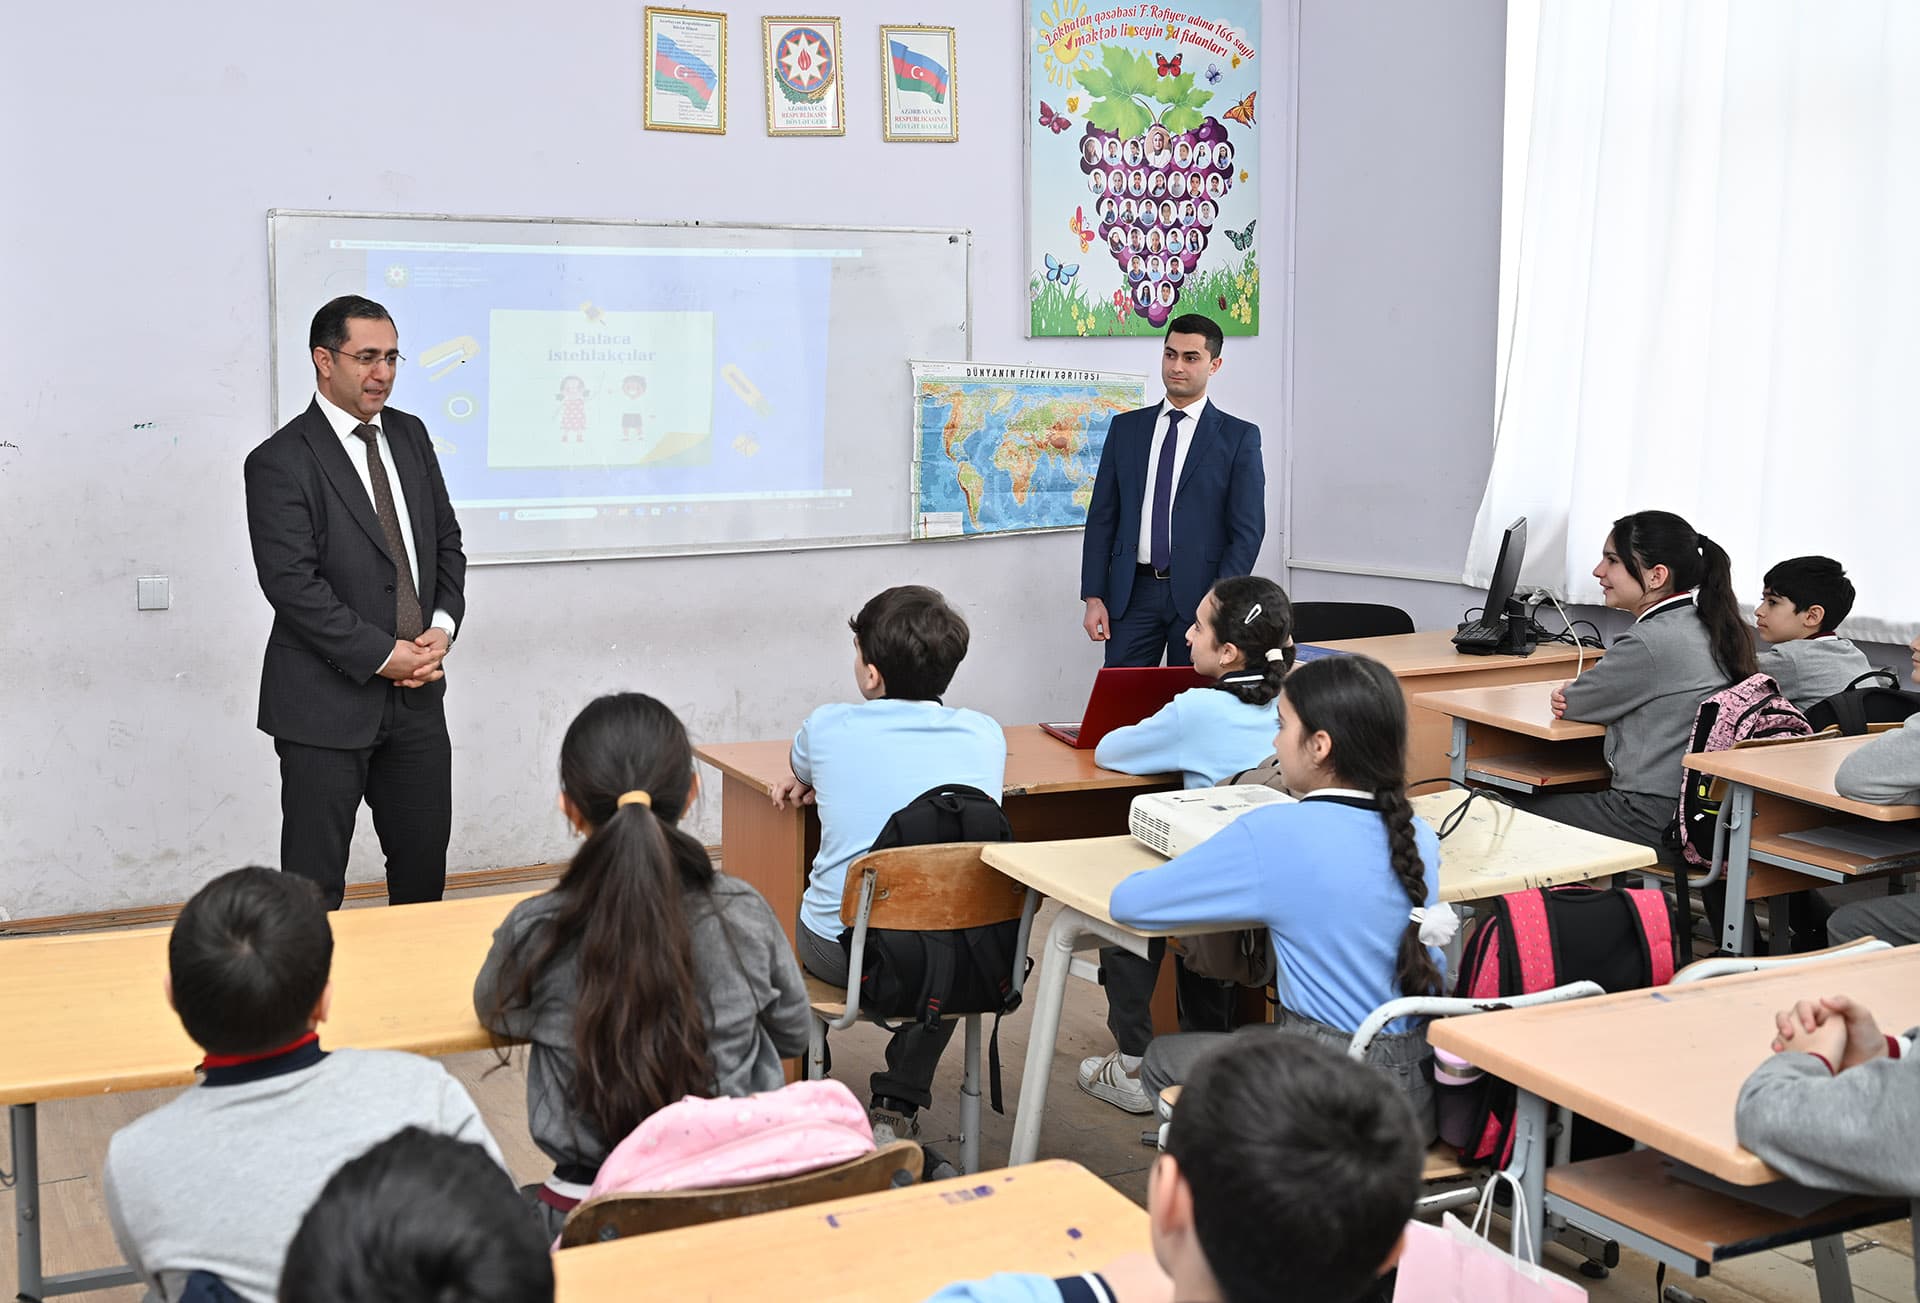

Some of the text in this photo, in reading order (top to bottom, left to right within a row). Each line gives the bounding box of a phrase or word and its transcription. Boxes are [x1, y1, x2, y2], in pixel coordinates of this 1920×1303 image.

[1094, 5, 1137, 24] qəsəbəsi
[1187, 15, 1215, 32] adına
[1215, 24, 1236, 42] 166
[1074, 24, 1118, 48] məktəb
[1179, 28, 1229, 57] fidanları
[574, 331, 632, 345] Balaca
[966, 366, 1016, 378] DÜNYANIN
